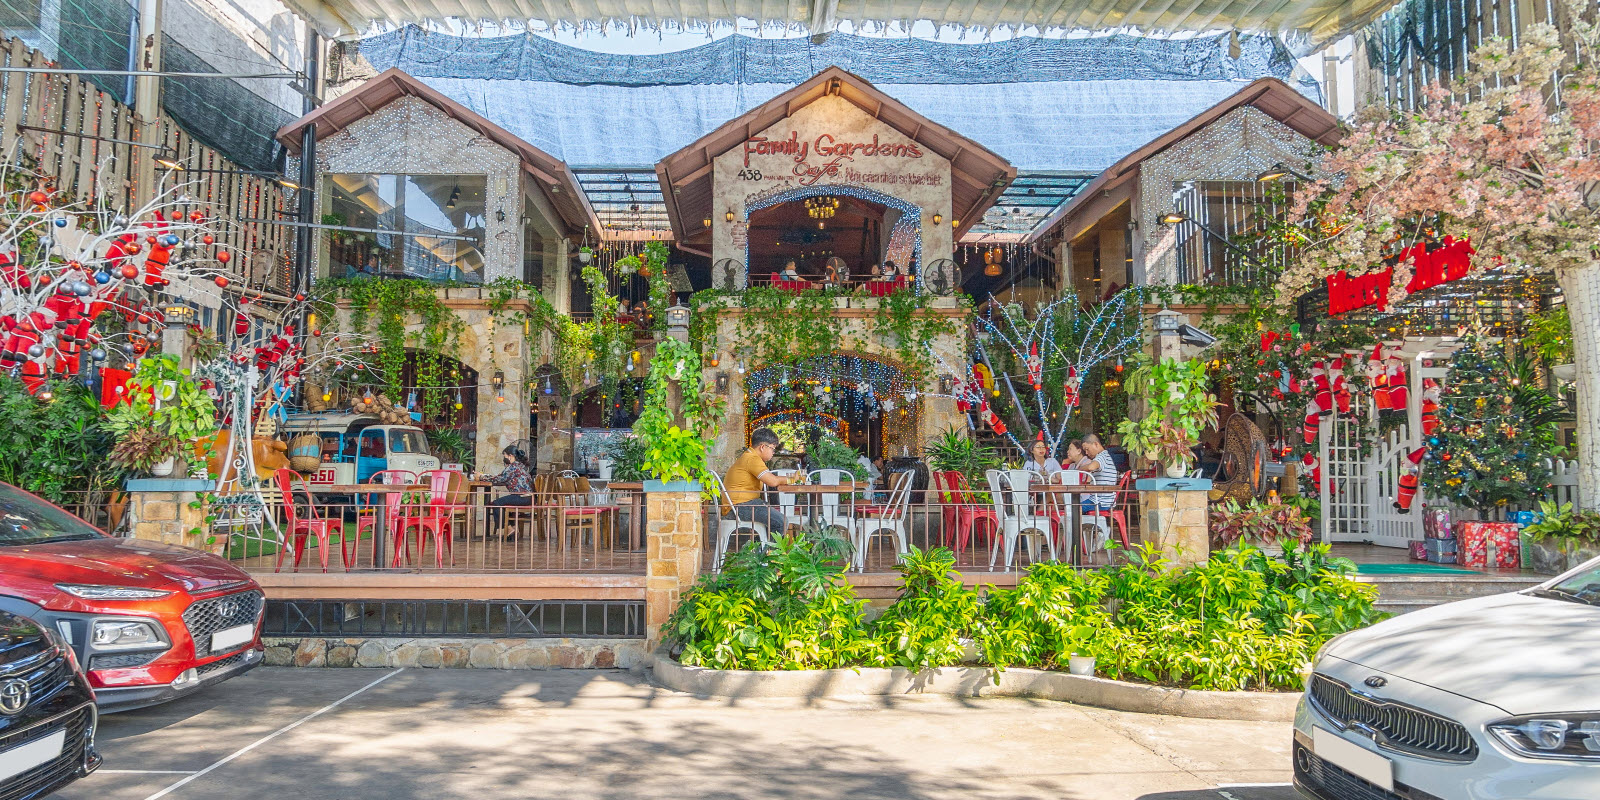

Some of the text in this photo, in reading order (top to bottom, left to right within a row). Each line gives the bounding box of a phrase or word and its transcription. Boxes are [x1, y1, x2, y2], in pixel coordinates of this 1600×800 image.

[744, 131, 923, 168] Family Gardens
[737, 169, 763, 181] 438
